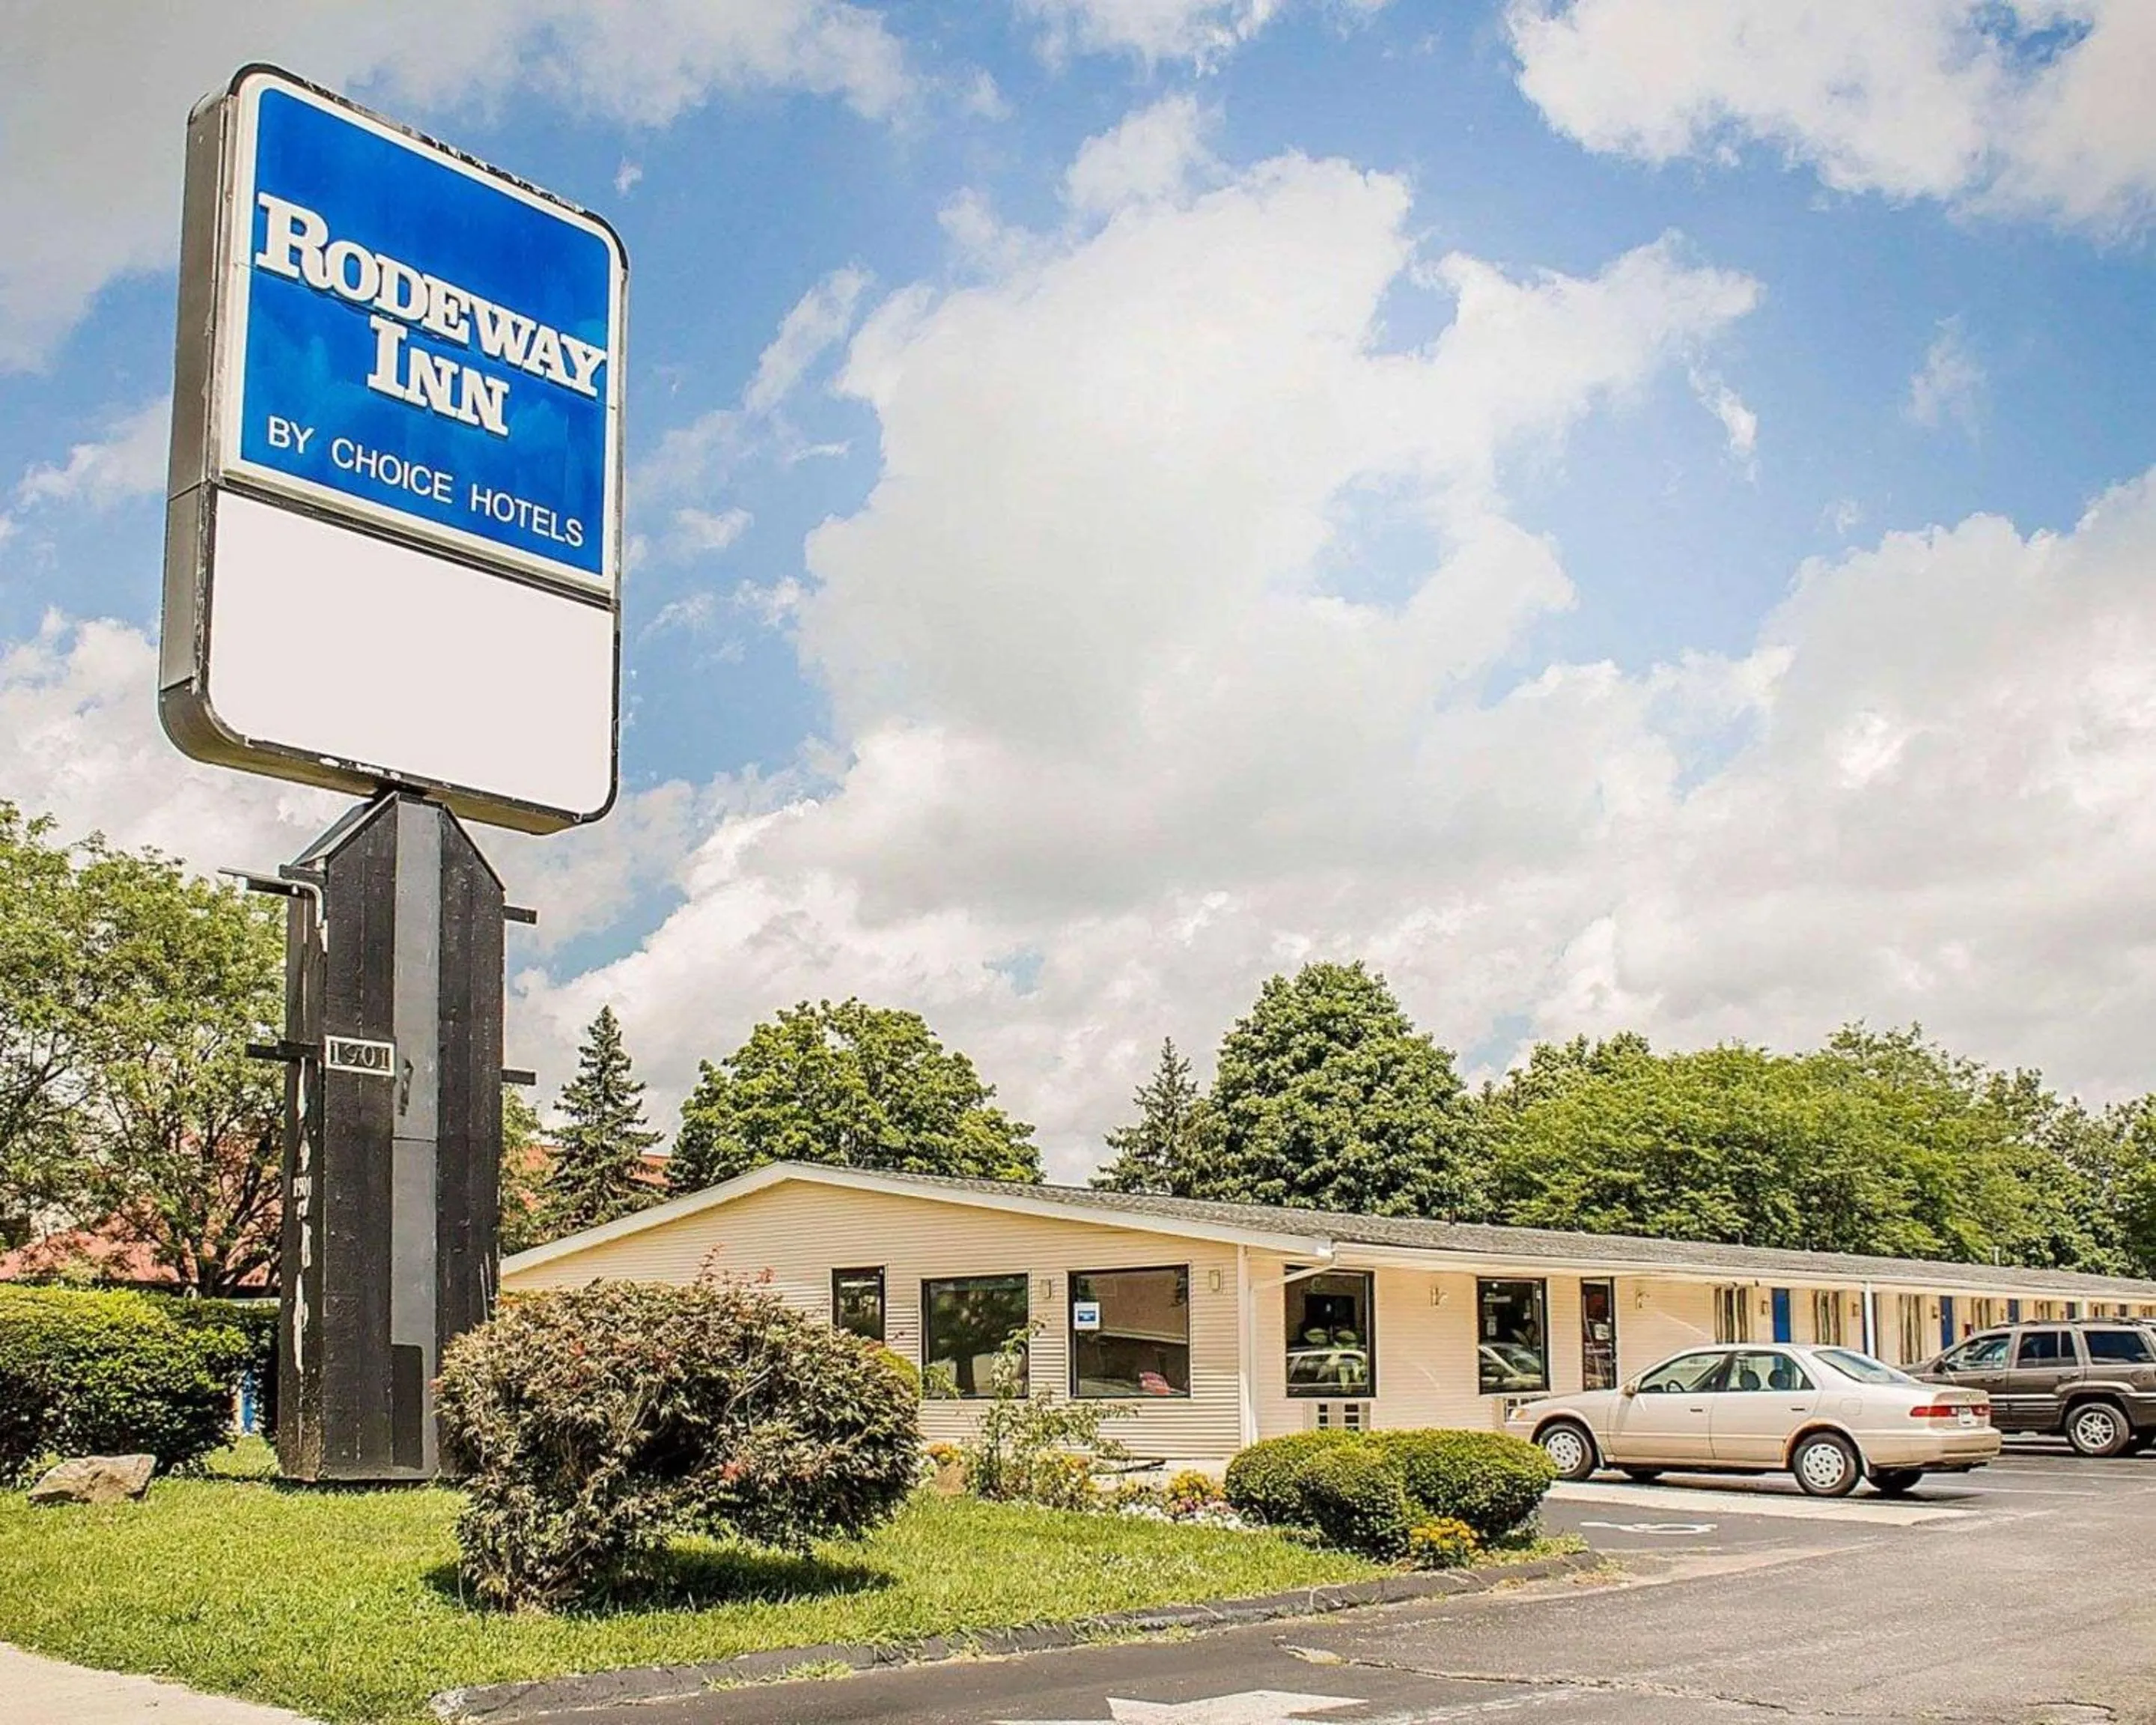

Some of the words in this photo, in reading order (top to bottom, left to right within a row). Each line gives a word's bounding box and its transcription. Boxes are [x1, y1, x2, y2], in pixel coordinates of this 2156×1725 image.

[256, 192, 607, 397] RODEWAY
[368, 315, 509, 436] INN
[268, 415, 314, 454] BY
[332, 438, 453, 503] CHOICE
[470, 484, 584, 547] HOTELS
[332, 1041, 388, 1069] 1901
